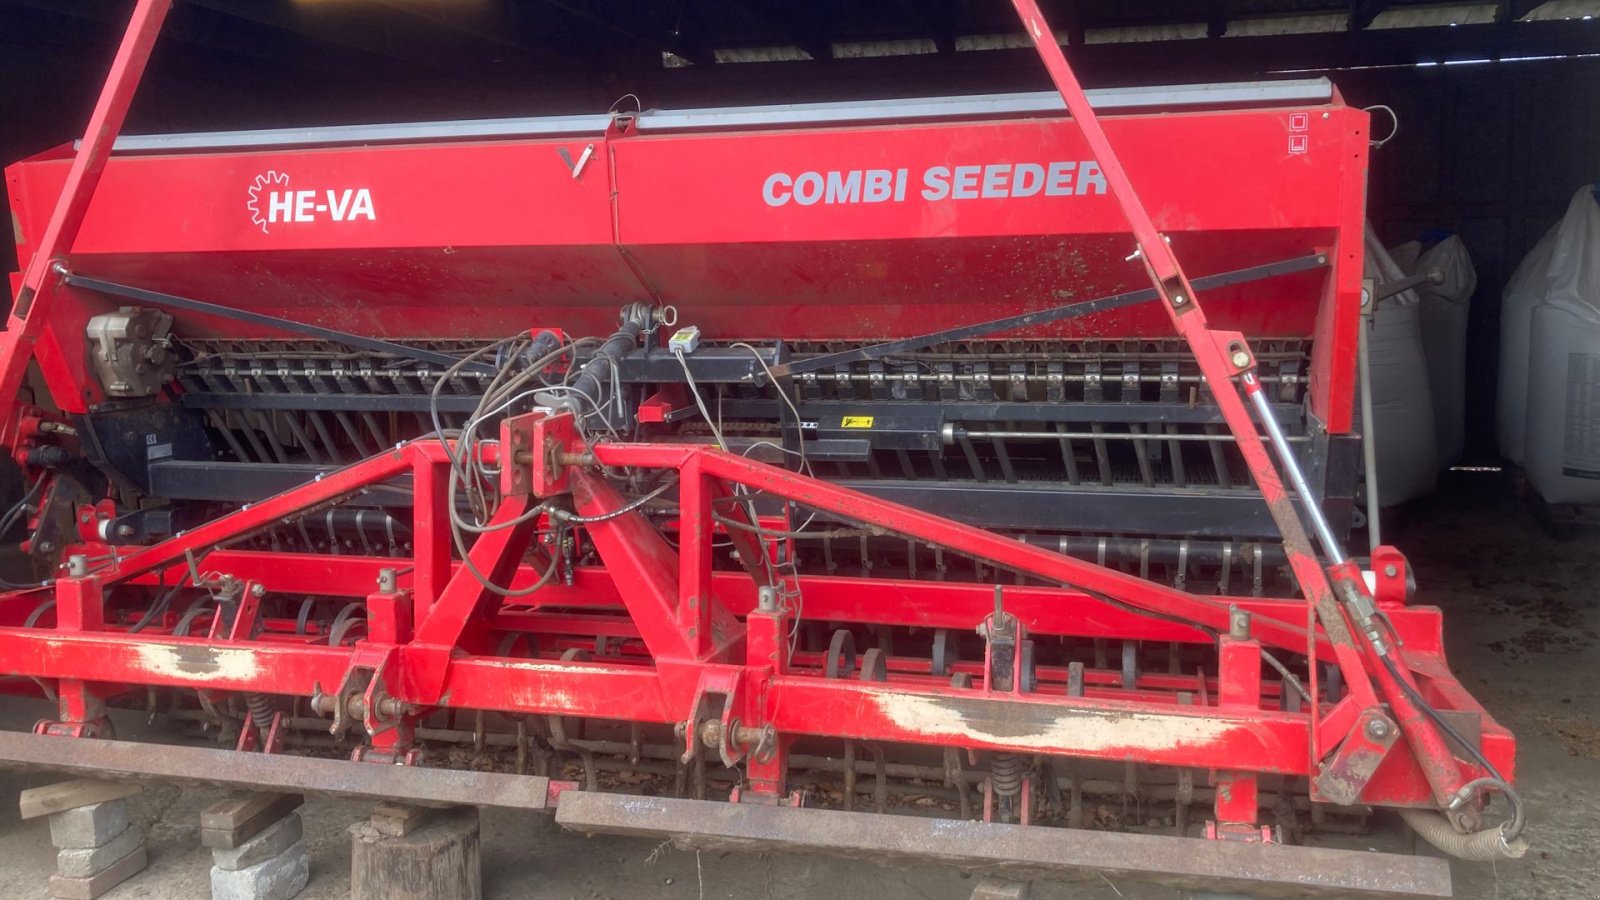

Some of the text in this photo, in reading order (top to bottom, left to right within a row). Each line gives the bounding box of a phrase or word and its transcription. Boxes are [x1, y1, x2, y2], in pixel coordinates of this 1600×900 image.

[762, 160, 1107, 207] COMBI SEEDER
[268, 189, 376, 222] HE-VA
